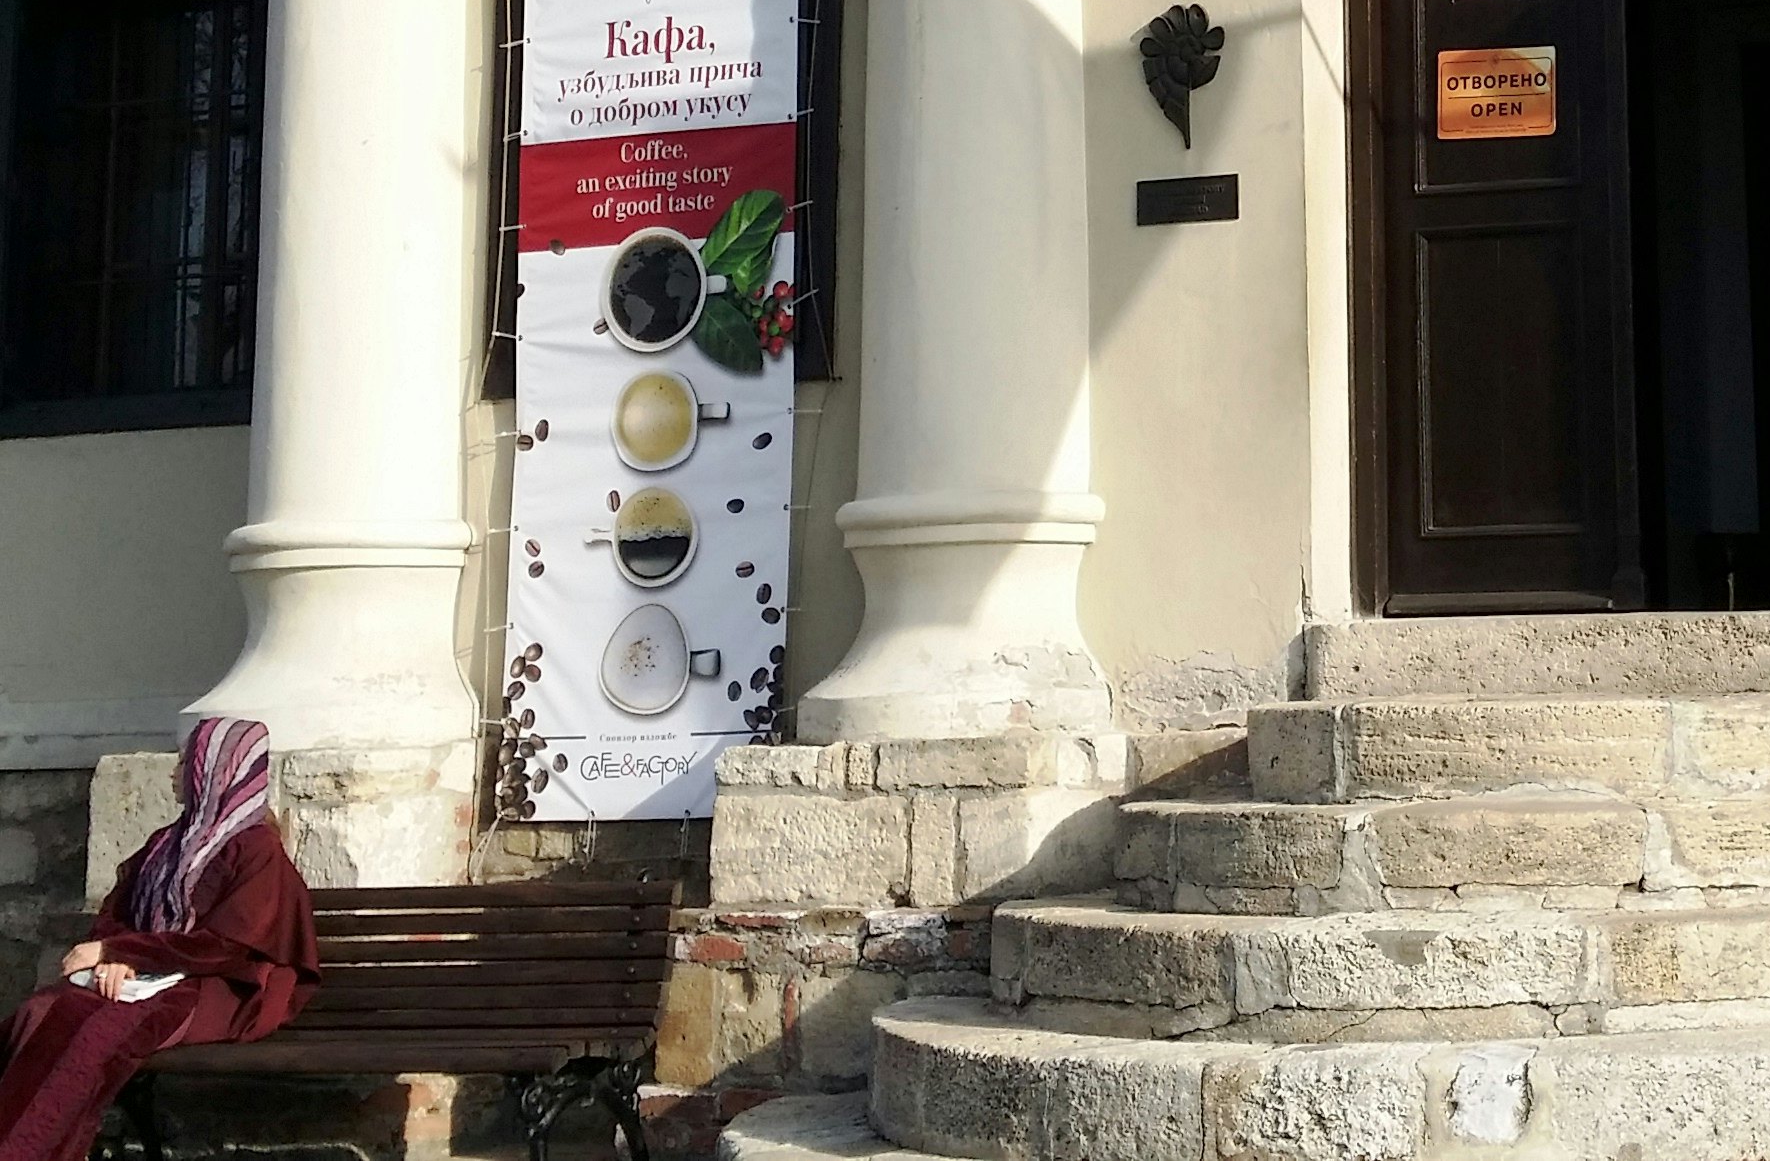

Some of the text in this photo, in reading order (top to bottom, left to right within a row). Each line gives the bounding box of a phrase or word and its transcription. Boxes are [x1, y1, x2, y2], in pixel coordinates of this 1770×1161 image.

[603, 16, 716, 63] Кафа,
[557, 60, 764, 103] узбудљива прича
[1446, 72, 1547, 91] ОТВОРЕНО
[570, 92, 752, 127] о добром укусу
[1470, 101, 1522, 117] OPEN
[576, 165, 733, 194] an exciting story
[592, 193, 715, 223] of good taste
